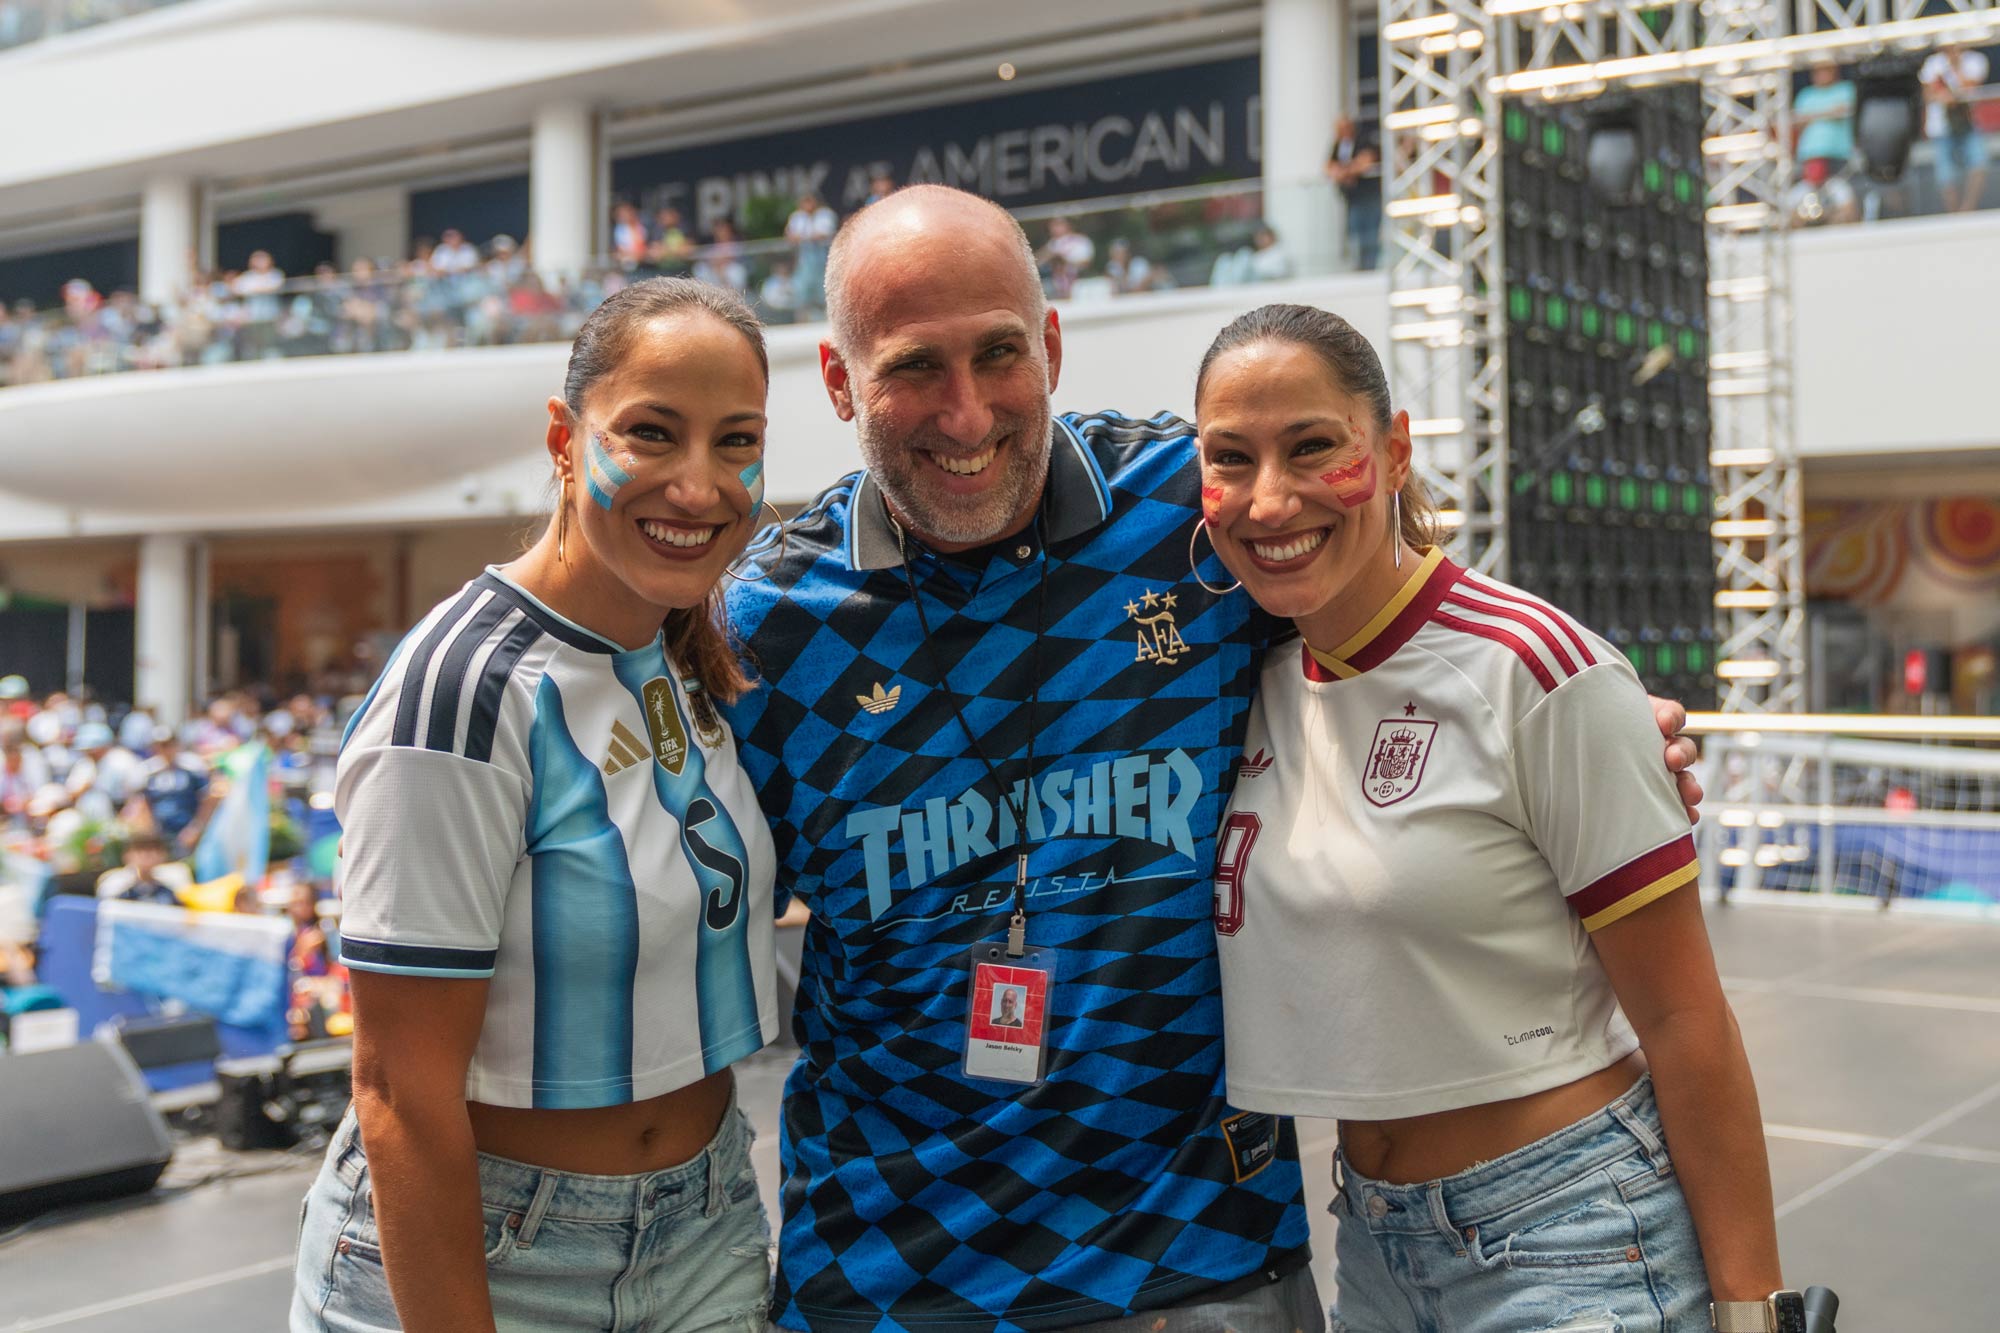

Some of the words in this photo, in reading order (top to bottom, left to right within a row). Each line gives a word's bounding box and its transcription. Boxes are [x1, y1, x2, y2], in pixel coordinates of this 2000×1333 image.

[908, 101, 1225, 197] AMERICAN
[1135, 611, 1191, 665] AFA
[660, 737, 679, 754] FIFA
[846, 747, 1203, 922] THRASHER
